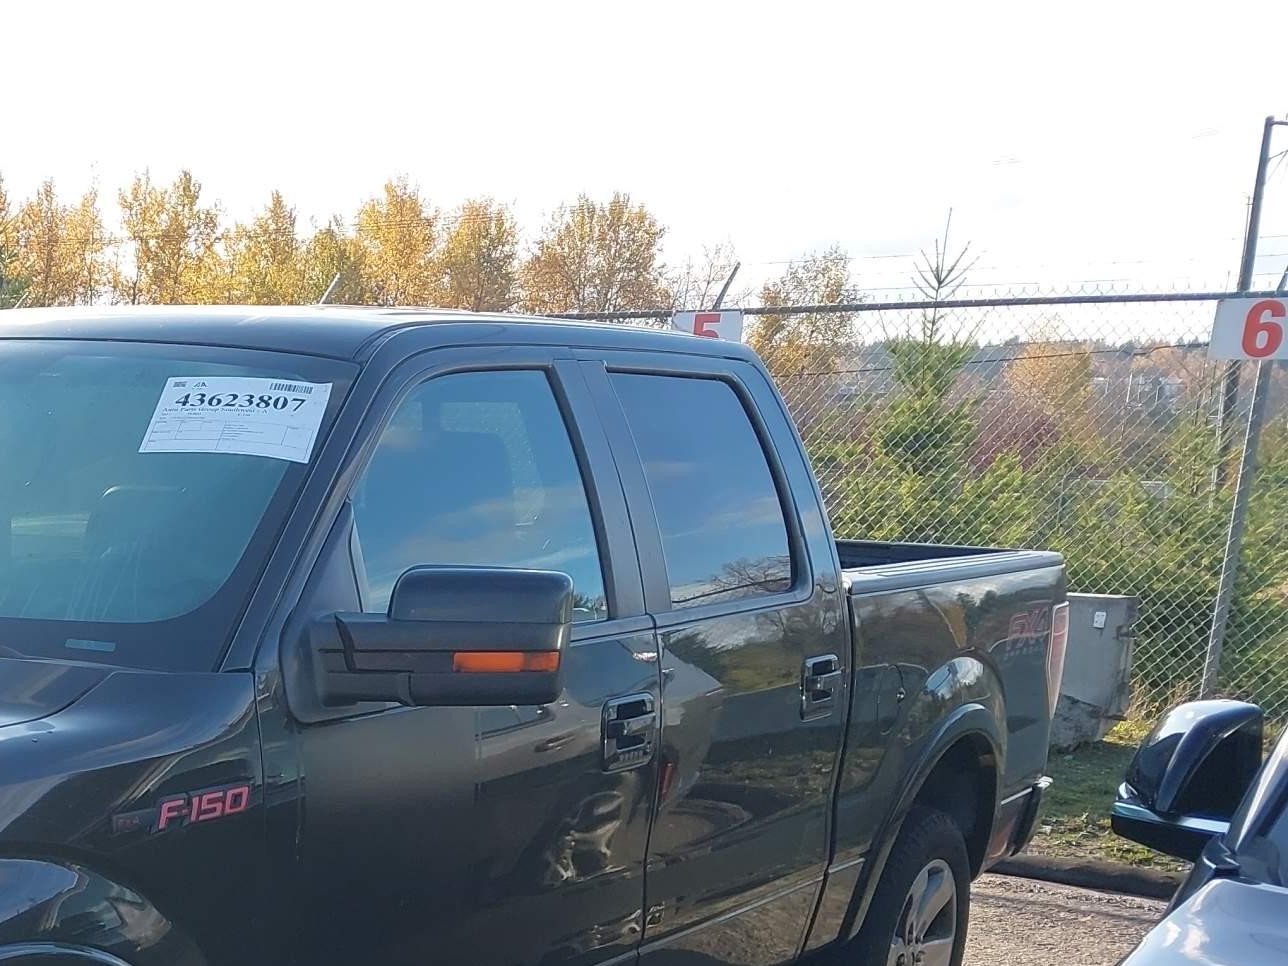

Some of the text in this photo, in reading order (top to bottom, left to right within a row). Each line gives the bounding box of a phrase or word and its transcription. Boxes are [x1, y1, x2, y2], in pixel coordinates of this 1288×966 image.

[1242, 299, 1287, 358] 6
[174, 392, 307, 412] 43623807
[157, 785, 250, 831] F-150
